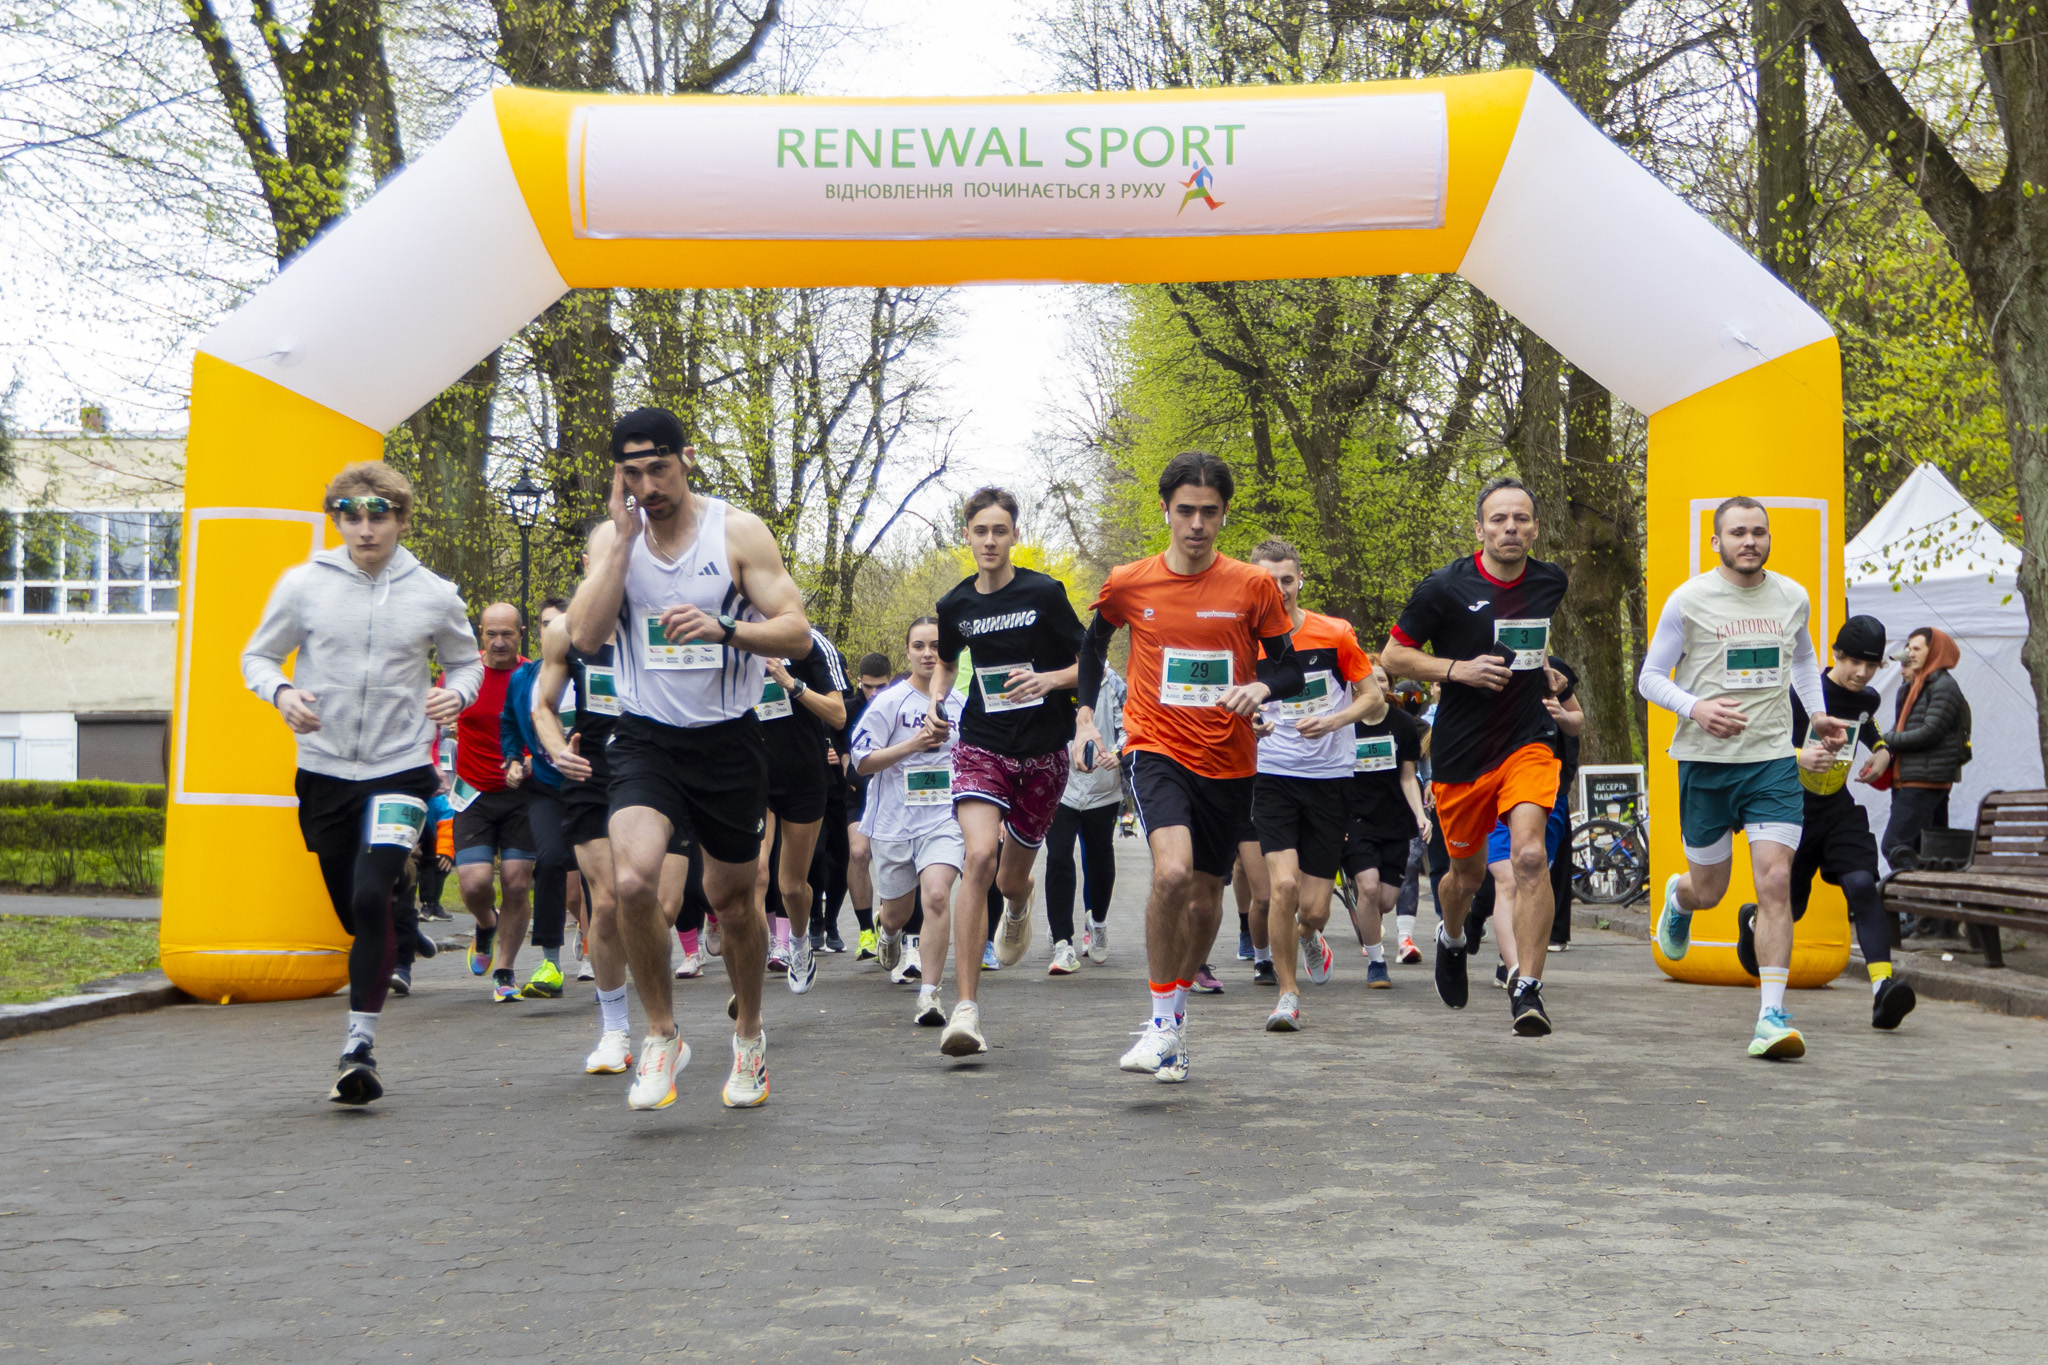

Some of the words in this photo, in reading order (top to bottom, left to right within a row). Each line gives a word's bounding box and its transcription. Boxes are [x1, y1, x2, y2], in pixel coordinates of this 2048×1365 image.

[777, 127, 1043, 168] RENEWAL
[1064, 124, 1246, 169] SPORT
[825, 183, 953, 202] ВІДНОВЛЕННЯ
[964, 182, 1100, 199] ПОЧИНАЄТЬСЯ
[1106, 184, 1116, 199] З
[1121, 183, 1166, 199] РУХУ
[972, 609, 1037, 635] RUNNING
[1716, 618, 1784, 640] CALIFORNIA
[1521, 629, 1528, 645] 3
[1752, 650, 1757, 664] 1
[1190, 661, 1209, 679] 29
[1367, 743, 1378, 755] 15
[924, 773, 936, 785] 24
